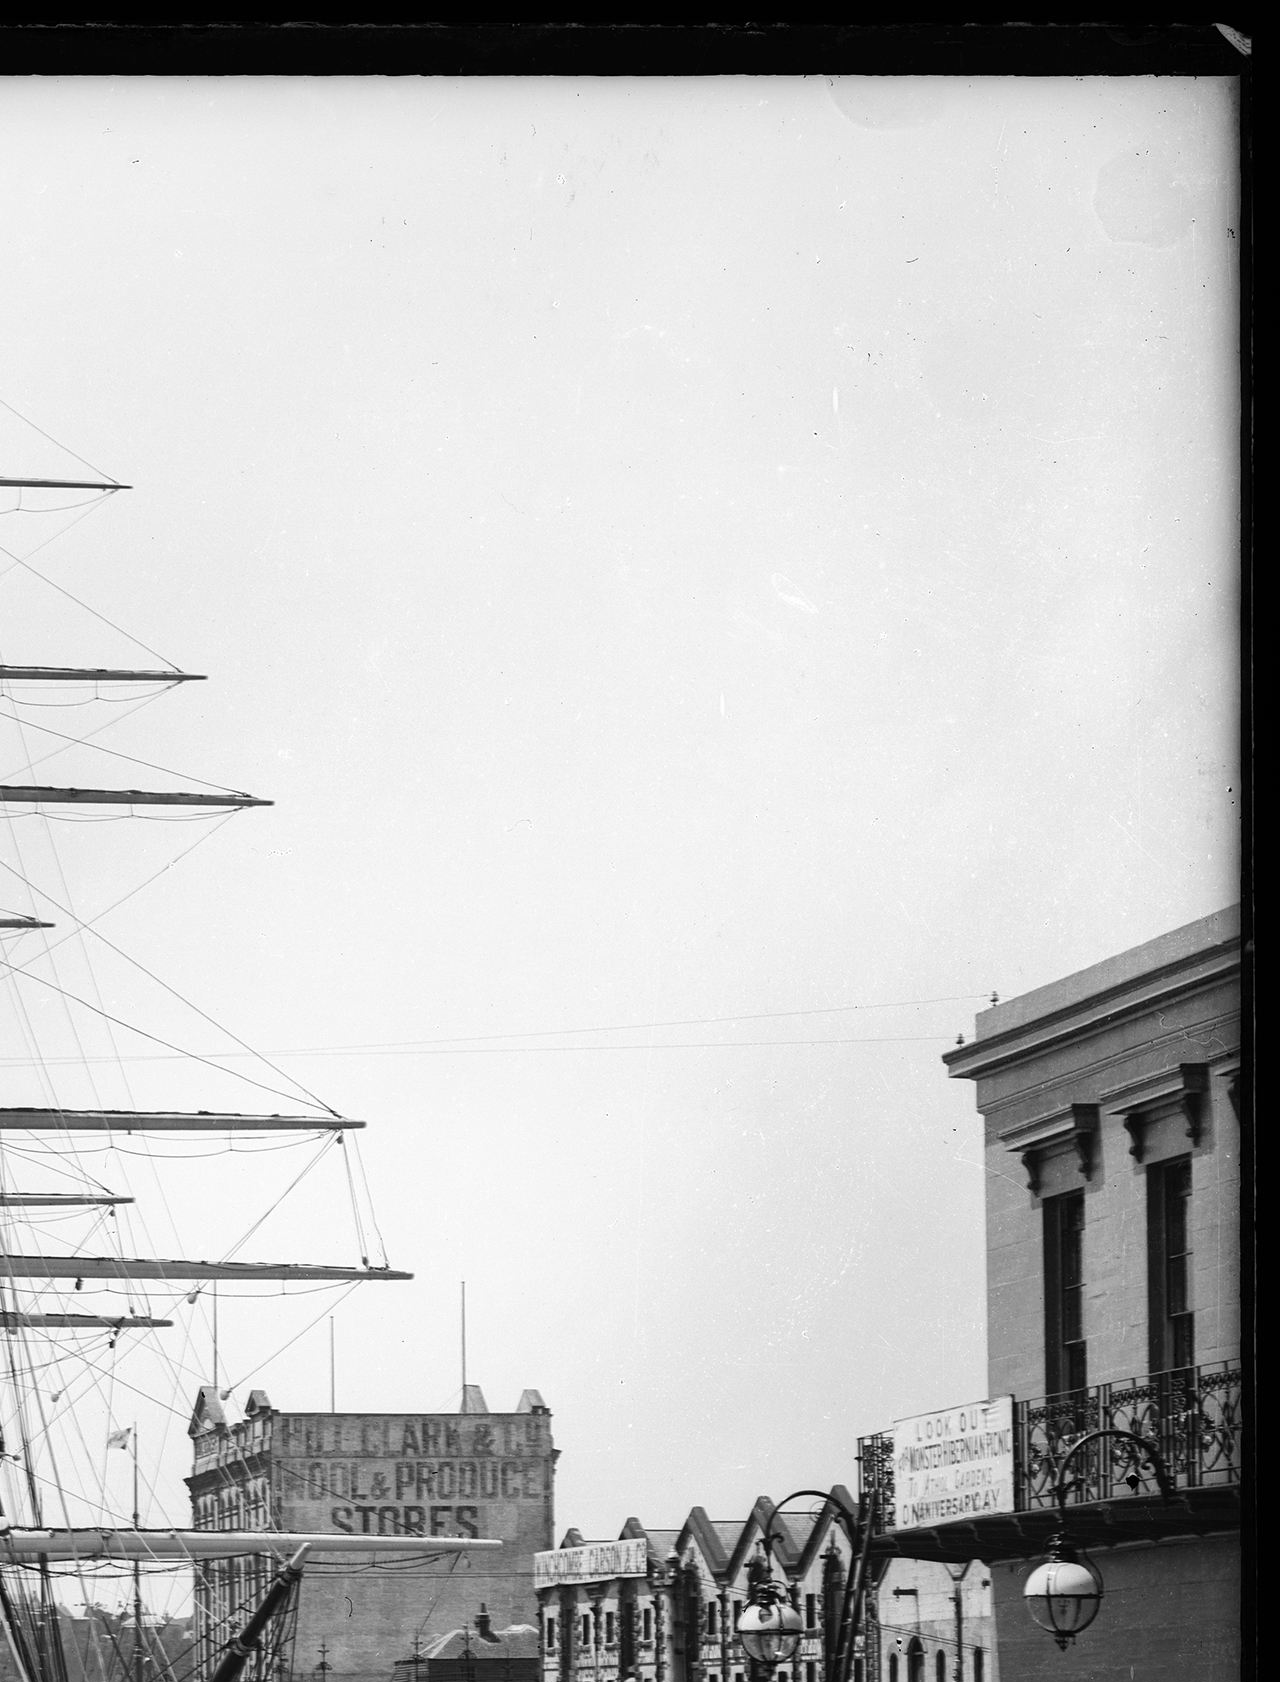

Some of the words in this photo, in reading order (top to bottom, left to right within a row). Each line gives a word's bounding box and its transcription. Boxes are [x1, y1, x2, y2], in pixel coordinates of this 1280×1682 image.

[473, 1423, 495, 1450] &
[916, 1415, 951, 1442] LOOK
[959, 1409, 990, 1432] OUT
[372, 1472, 391, 1500] &
[396, 1462, 543, 1500] PRODUCE
[955, 1467, 992, 1489] GARDENS
[332, 1505, 479, 1539] STORES
[903, 1504, 920, 1525] ON
[973, 1488, 1000, 1511] DAY
